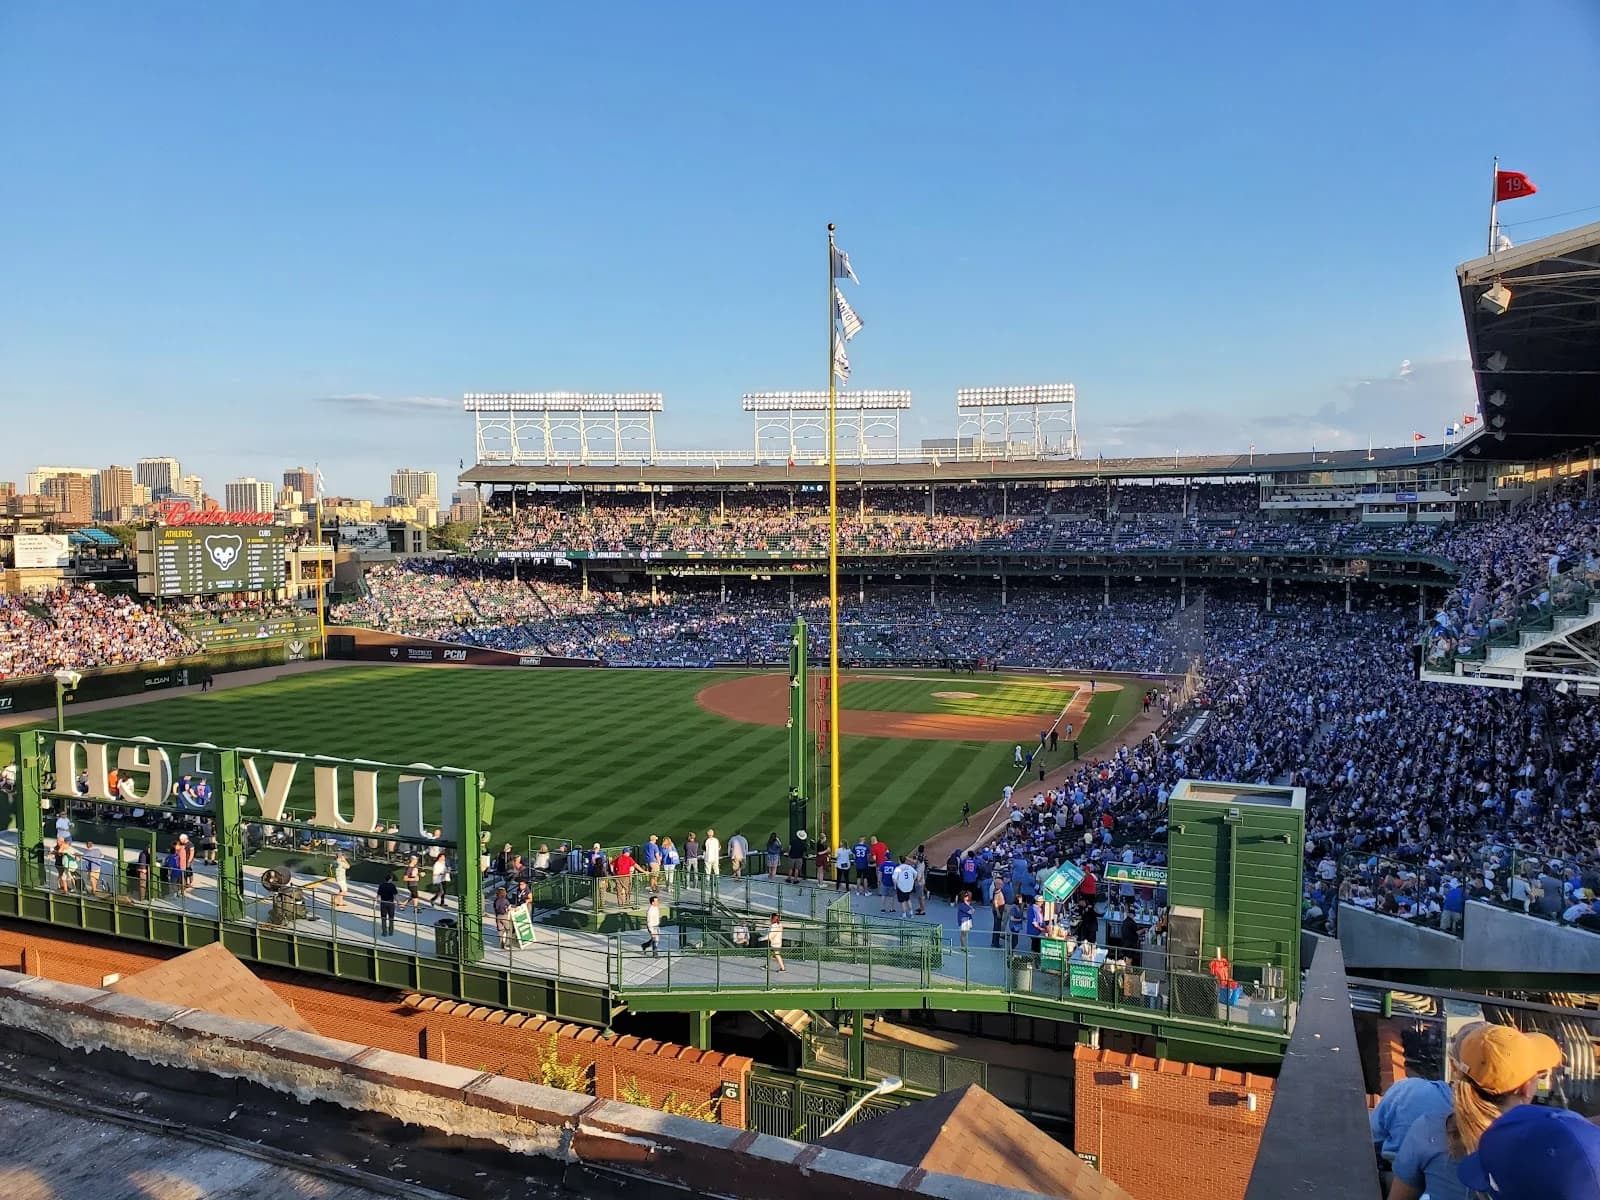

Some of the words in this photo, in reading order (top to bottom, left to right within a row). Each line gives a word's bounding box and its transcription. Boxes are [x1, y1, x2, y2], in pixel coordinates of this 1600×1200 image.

[160, 499, 274, 527] Budweiser
[165, 530, 193, 538] ATHLETICS
[443, 649, 467, 660] PCM
[145, 676, 170, 685] SLOAN
[1072, 978, 1096, 988] TEQUILA
[725, 1087, 737, 1098] 6
